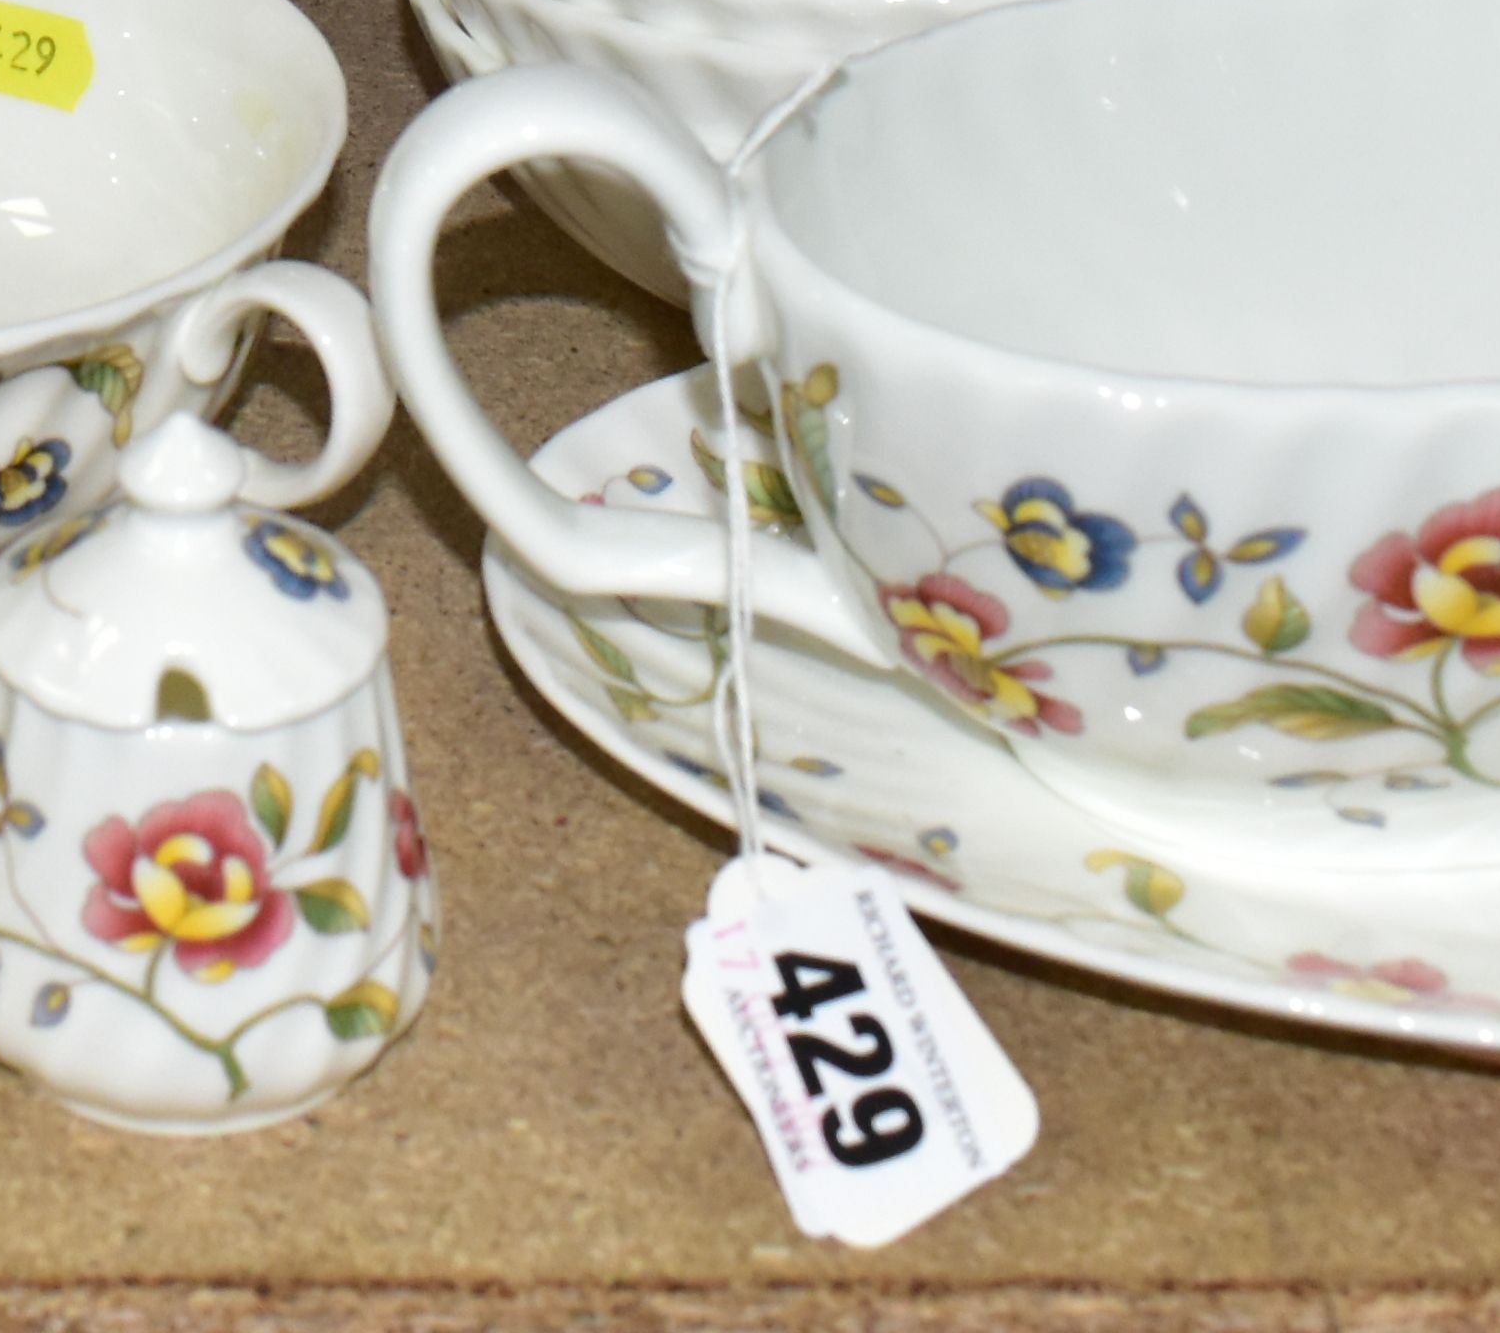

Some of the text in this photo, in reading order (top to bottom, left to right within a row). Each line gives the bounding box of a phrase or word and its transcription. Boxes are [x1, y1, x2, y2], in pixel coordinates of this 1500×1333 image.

[725, 986, 811, 1175] AUCTIONEERS
[769, 949, 925, 1168] 429
[857, 891, 984, 1170] RICHARD WINTERTON
